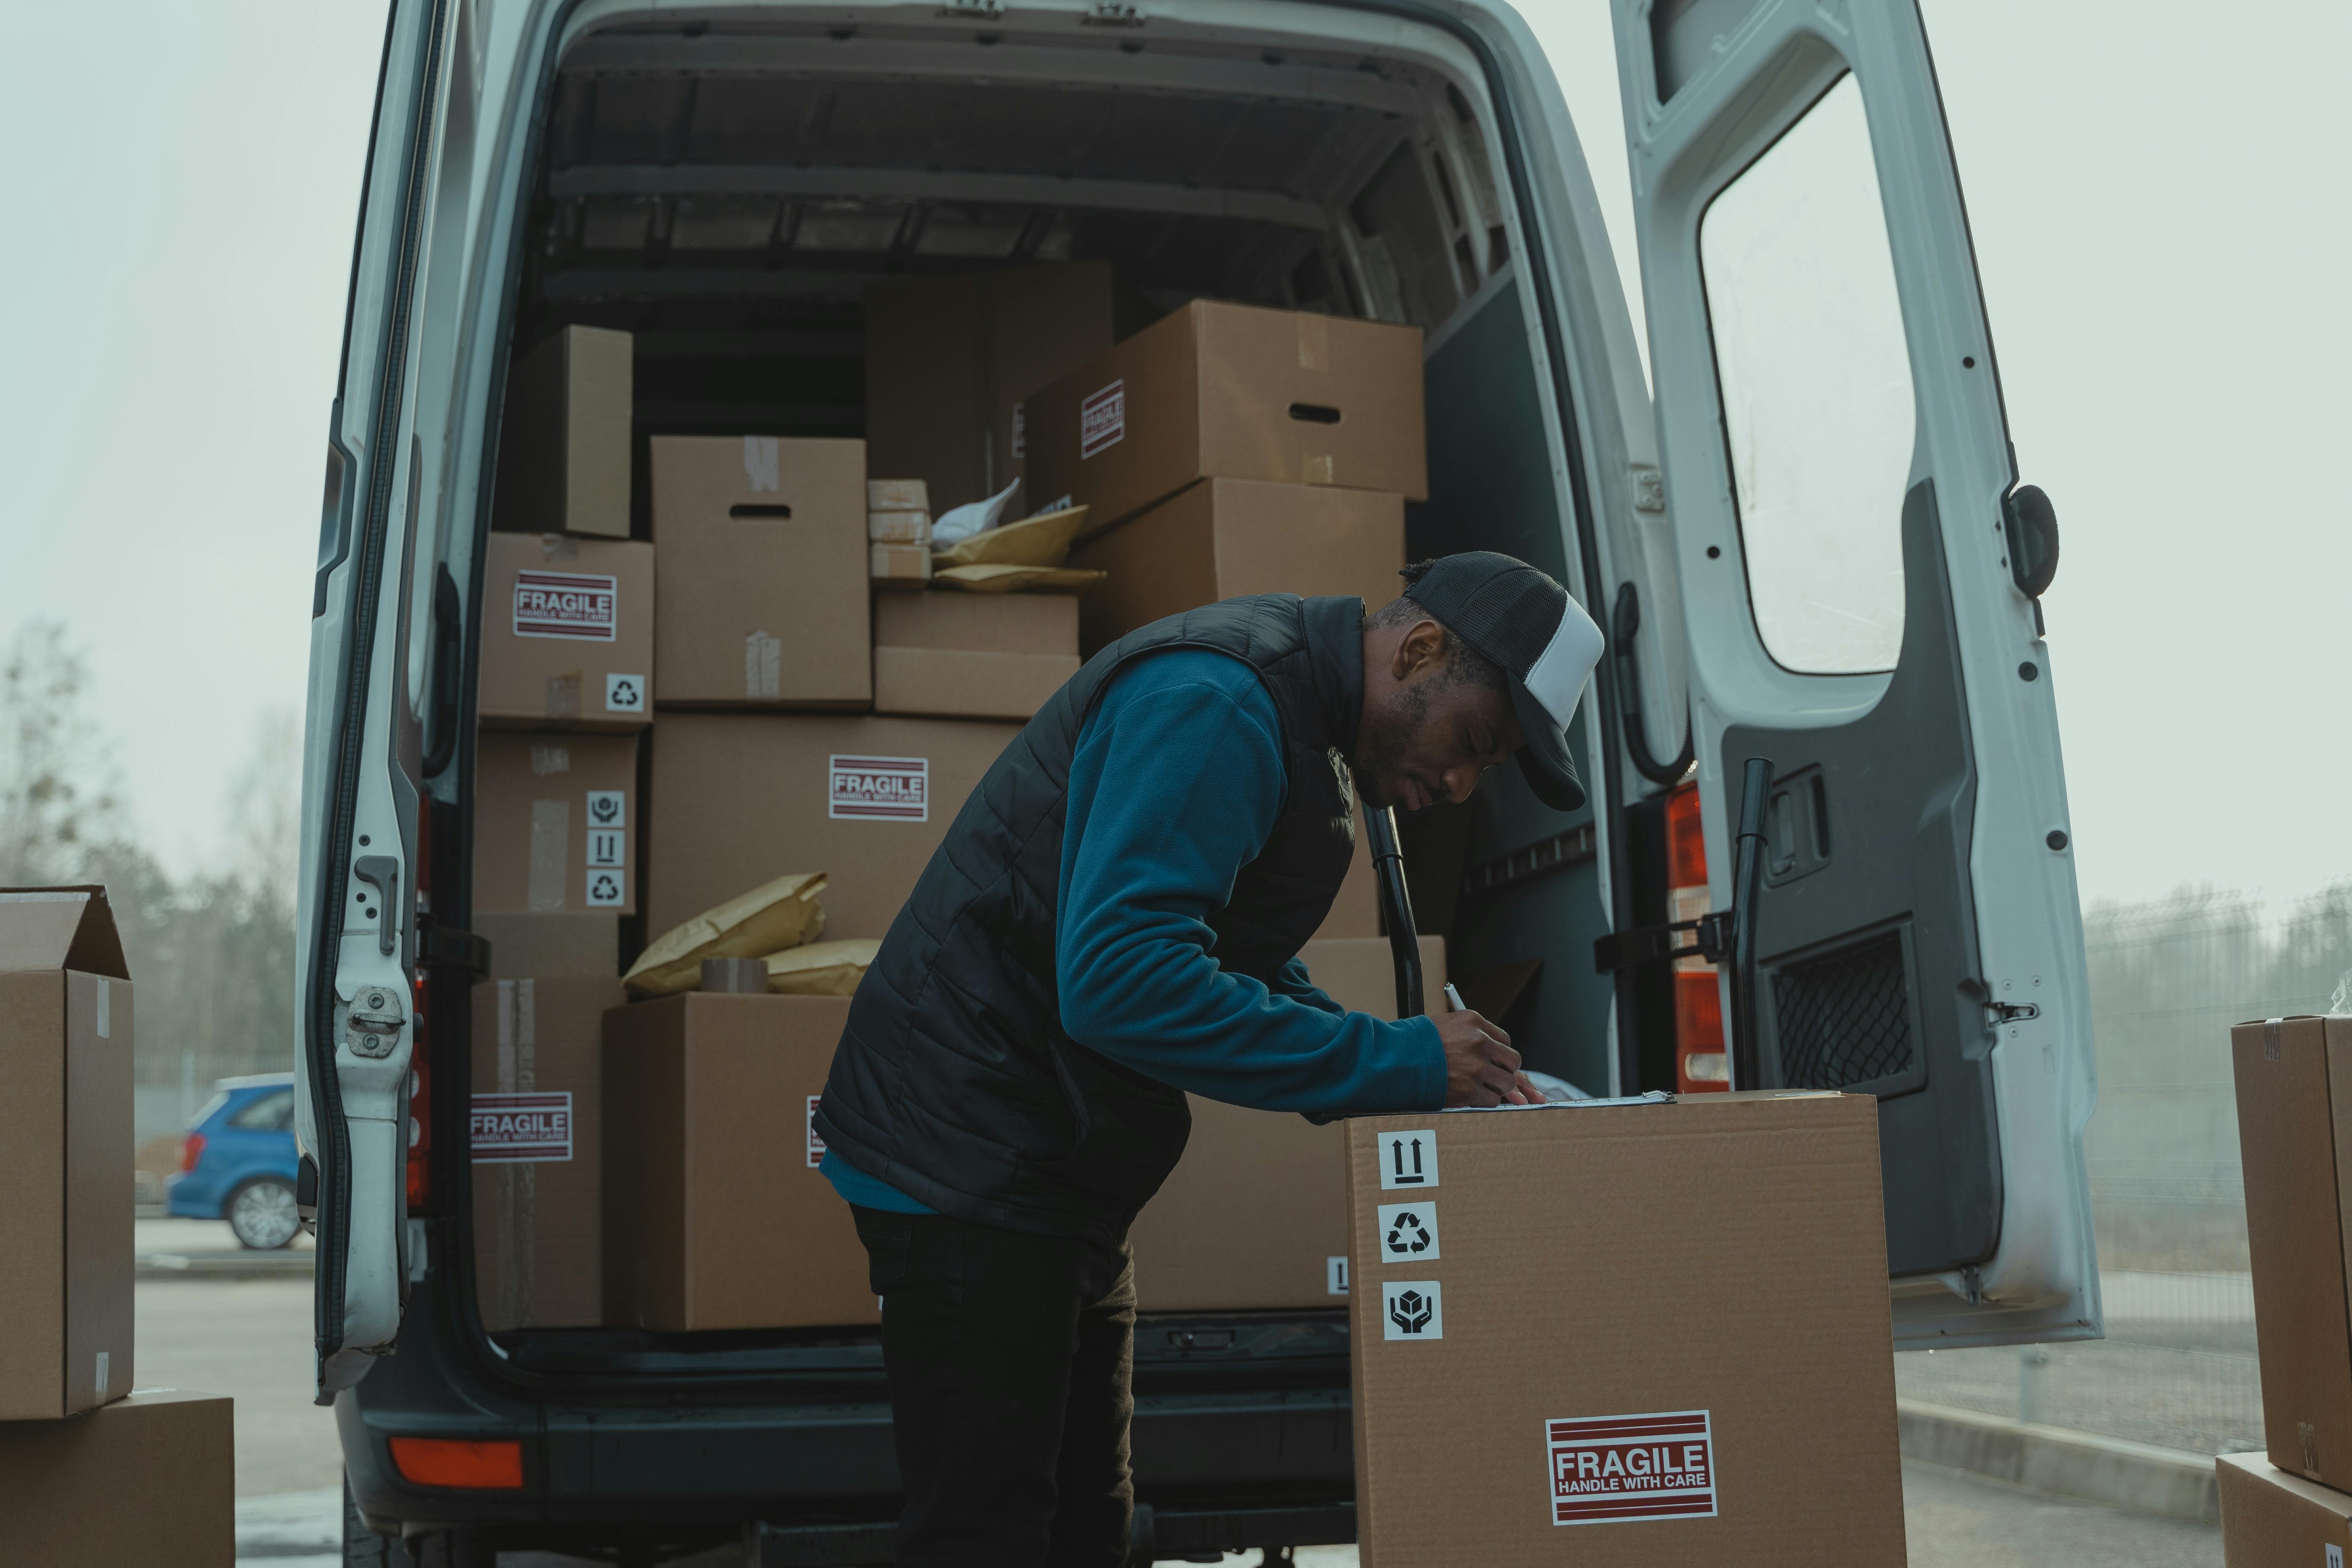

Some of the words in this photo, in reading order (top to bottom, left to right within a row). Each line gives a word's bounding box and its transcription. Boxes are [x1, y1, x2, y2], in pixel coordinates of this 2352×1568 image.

[519, 590, 610, 613] FRAGILE
[835, 775, 922, 795] FRAGILE
[471, 1113, 566, 1134] FRAGILE
[1556, 1445, 1705, 1479] FRAGILE
[1559, 1478, 1620, 1493] HANDLE
[1623, 1476, 1661, 1489] WITH
[1664, 1473, 1706, 1487] CARE
